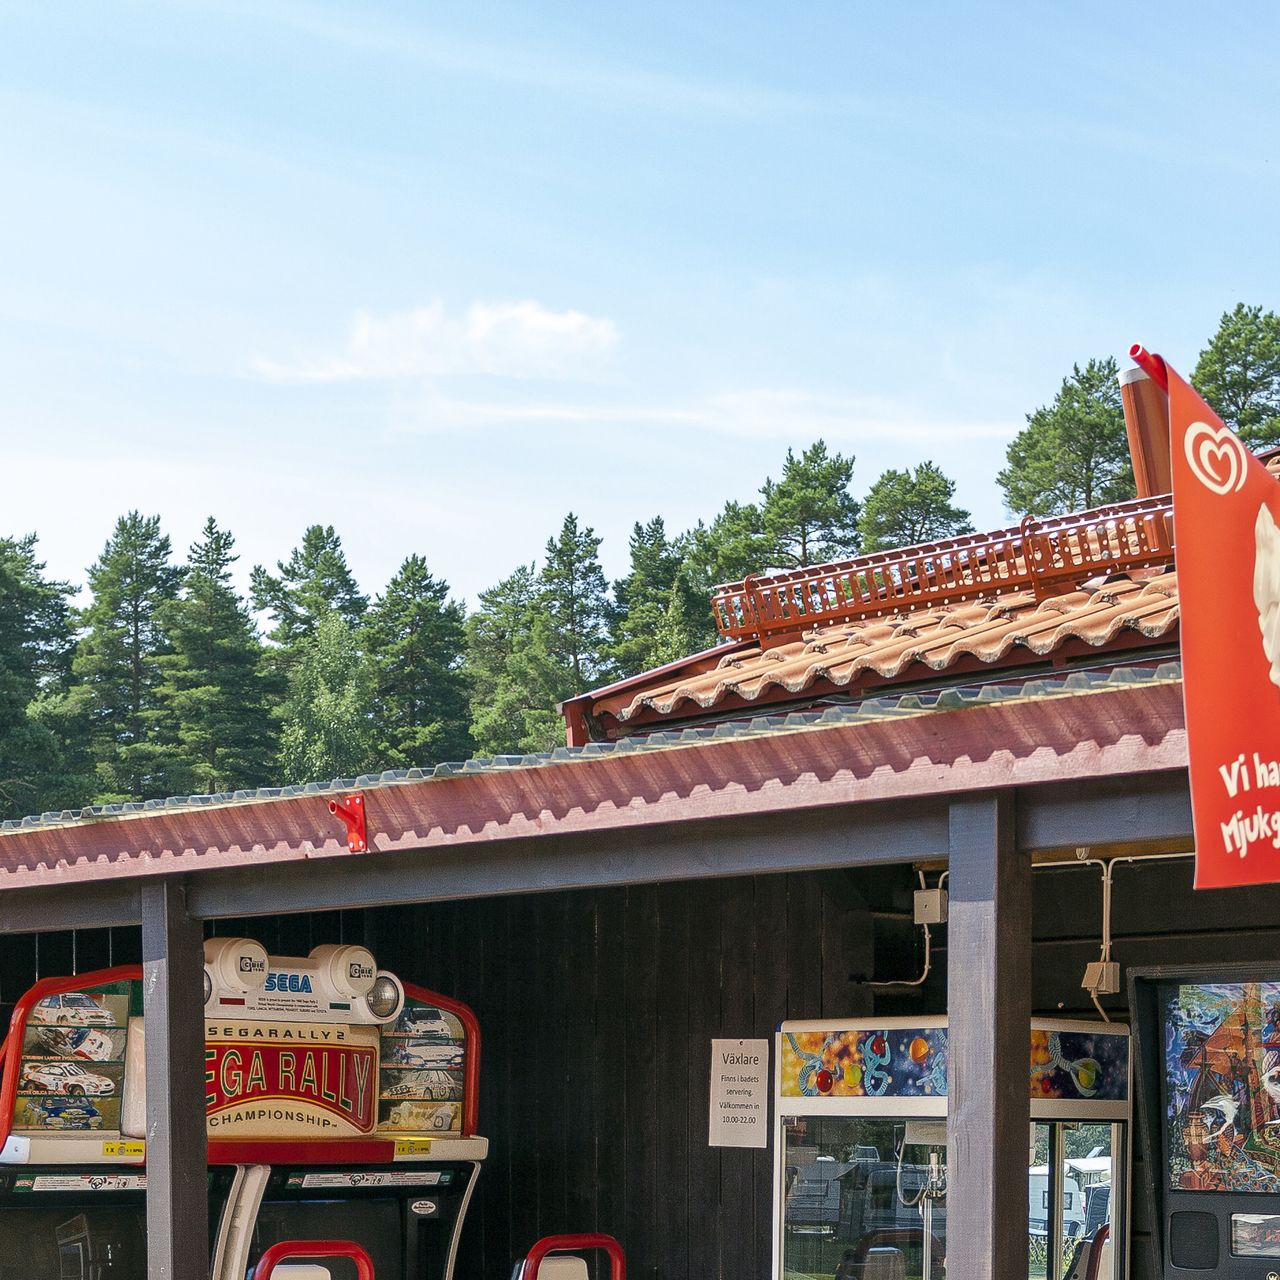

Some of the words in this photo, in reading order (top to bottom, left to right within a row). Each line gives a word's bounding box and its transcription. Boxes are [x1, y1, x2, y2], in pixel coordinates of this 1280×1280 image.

[1219, 752, 1250, 798] Vi
[265, 973, 313, 994] SEGA
[722, 1053, 759, 1065] Växlare
[721, 1074, 736, 1083] Finns
[740, 1075, 759, 1083] badets
[205, 1050, 267, 1106] EGA
[279, 1051, 371, 1120] RALLY
[719, 1101, 753, 1109] Välkommen
[722, 1115, 756, 1124] 10.00-22.00
